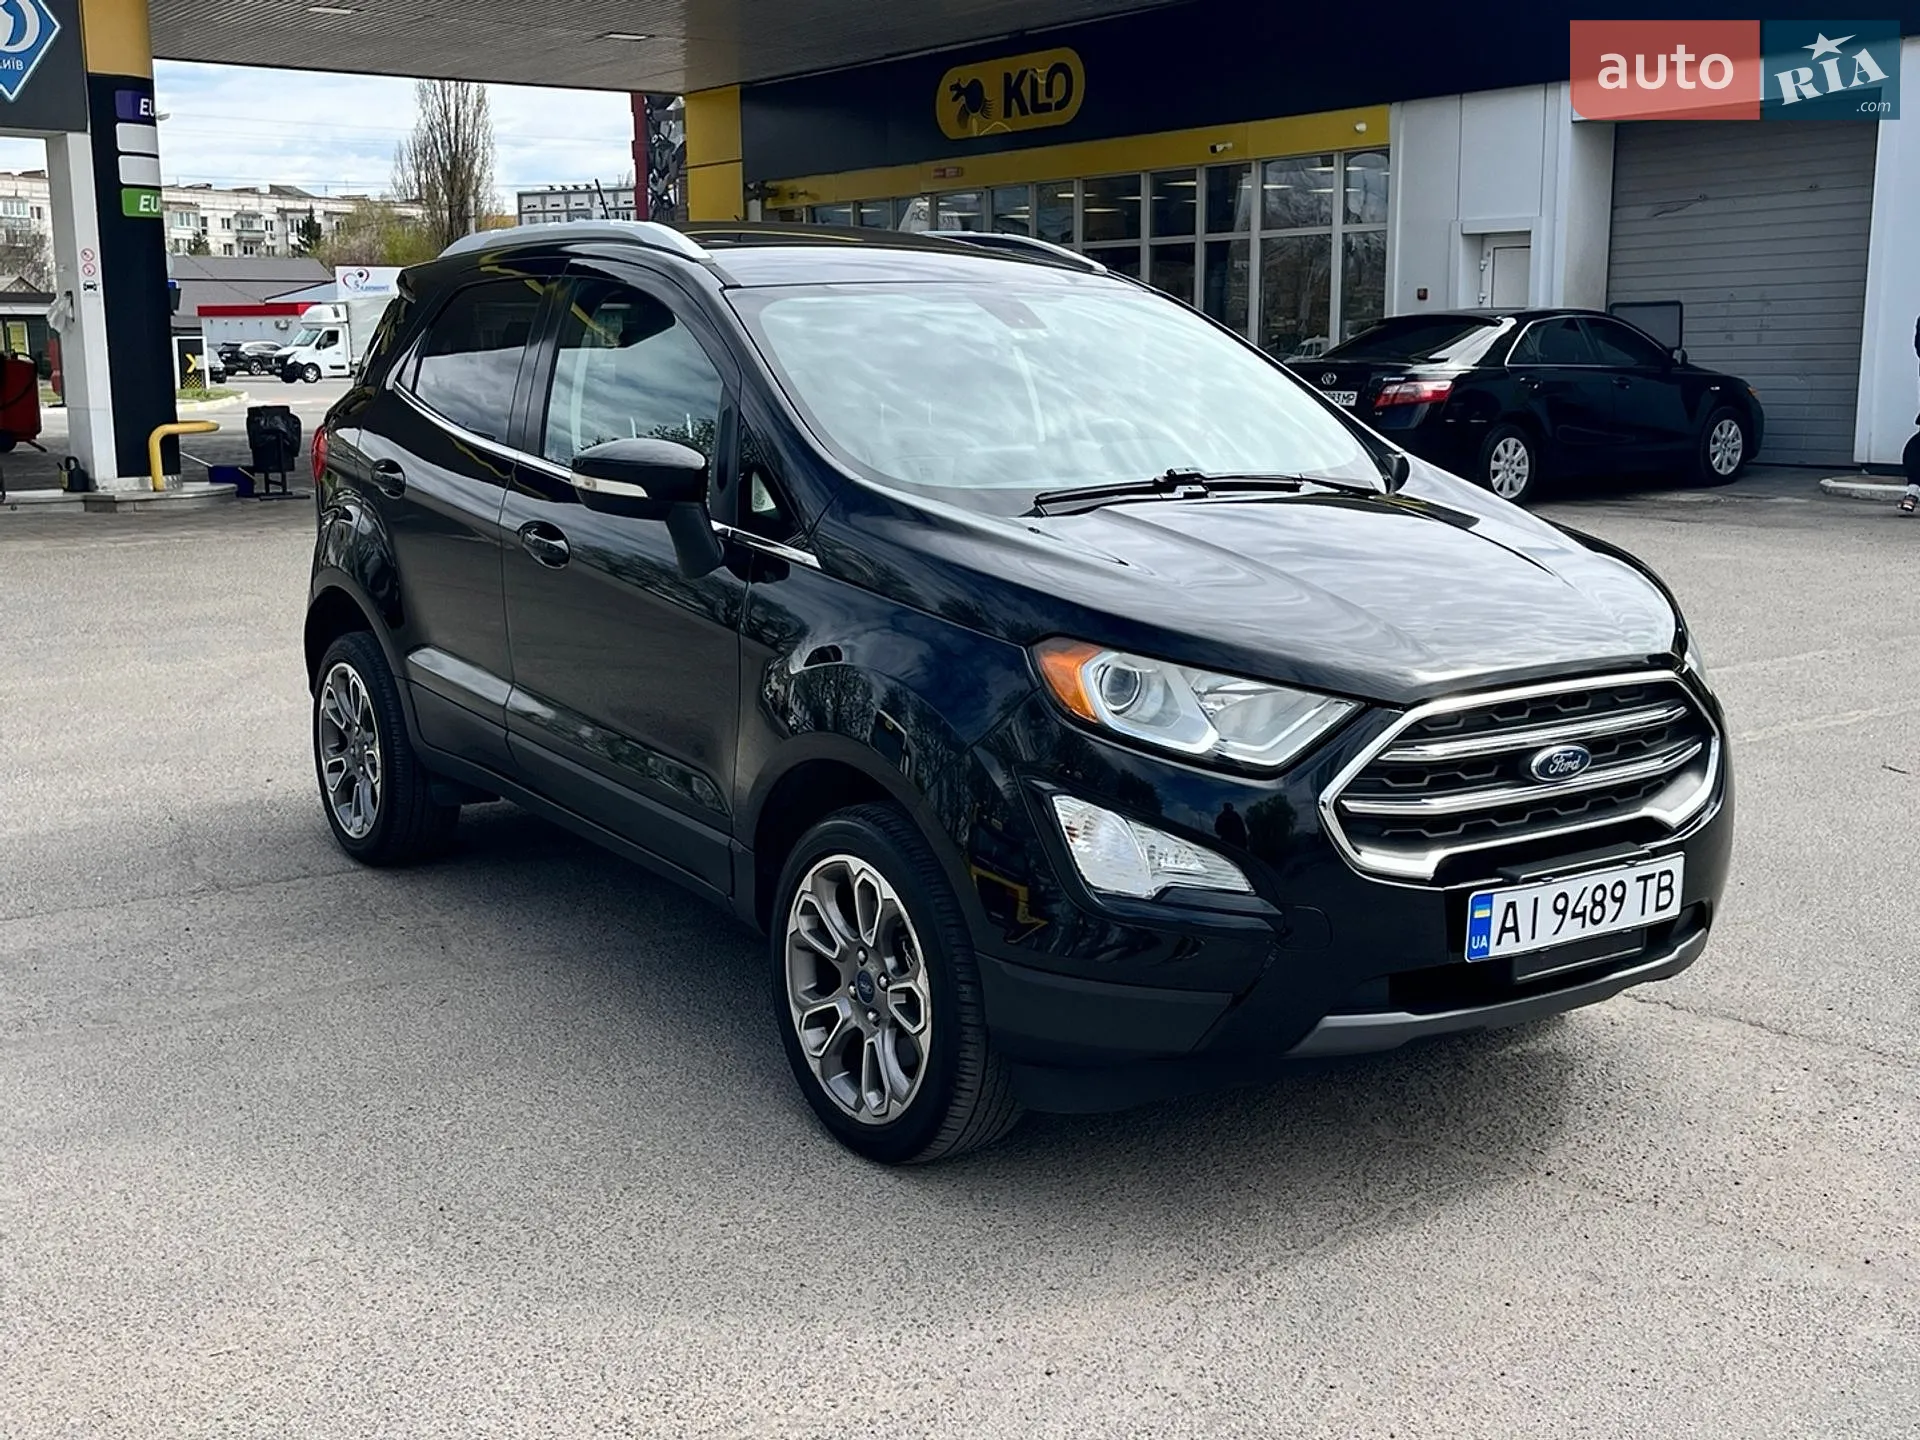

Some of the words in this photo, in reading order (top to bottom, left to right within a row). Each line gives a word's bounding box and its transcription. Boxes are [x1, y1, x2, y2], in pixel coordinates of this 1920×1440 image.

[1003, 62, 1074, 119] KLO
[138, 194, 160, 213] EU
[1548, 750, 1581, 774] Ford
[1495, 896, 1539, 947] AI
[1552, 879, 1627, 936] 9489
[1635, 868, 1675, 917] TB
[1471, 934, 1488, 949] UA
